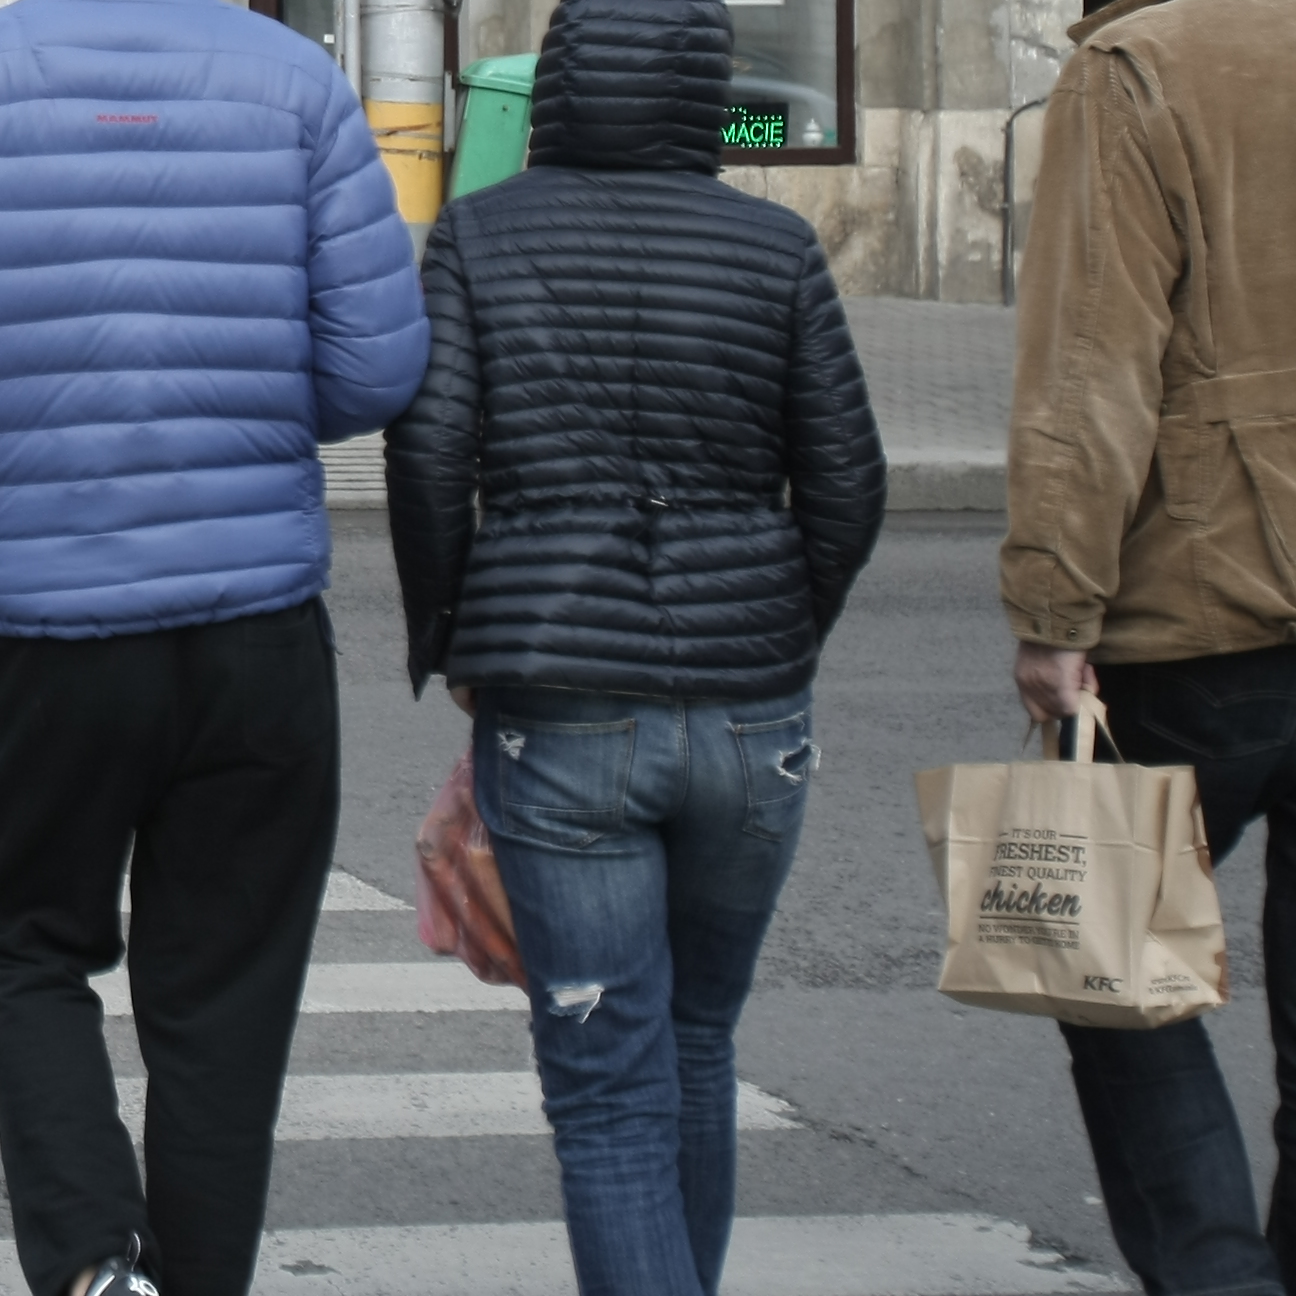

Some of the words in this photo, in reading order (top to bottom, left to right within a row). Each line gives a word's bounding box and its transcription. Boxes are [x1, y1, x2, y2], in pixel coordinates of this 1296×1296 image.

[1012, 828, 1032, 839] IT'S
[1033, 829, 1057, 840] OUR
[1026, 866, 1088, 882] QUALITY
[980, 879, 1083, 918] chicken
[1084, 974, 1124, 994] KFC
